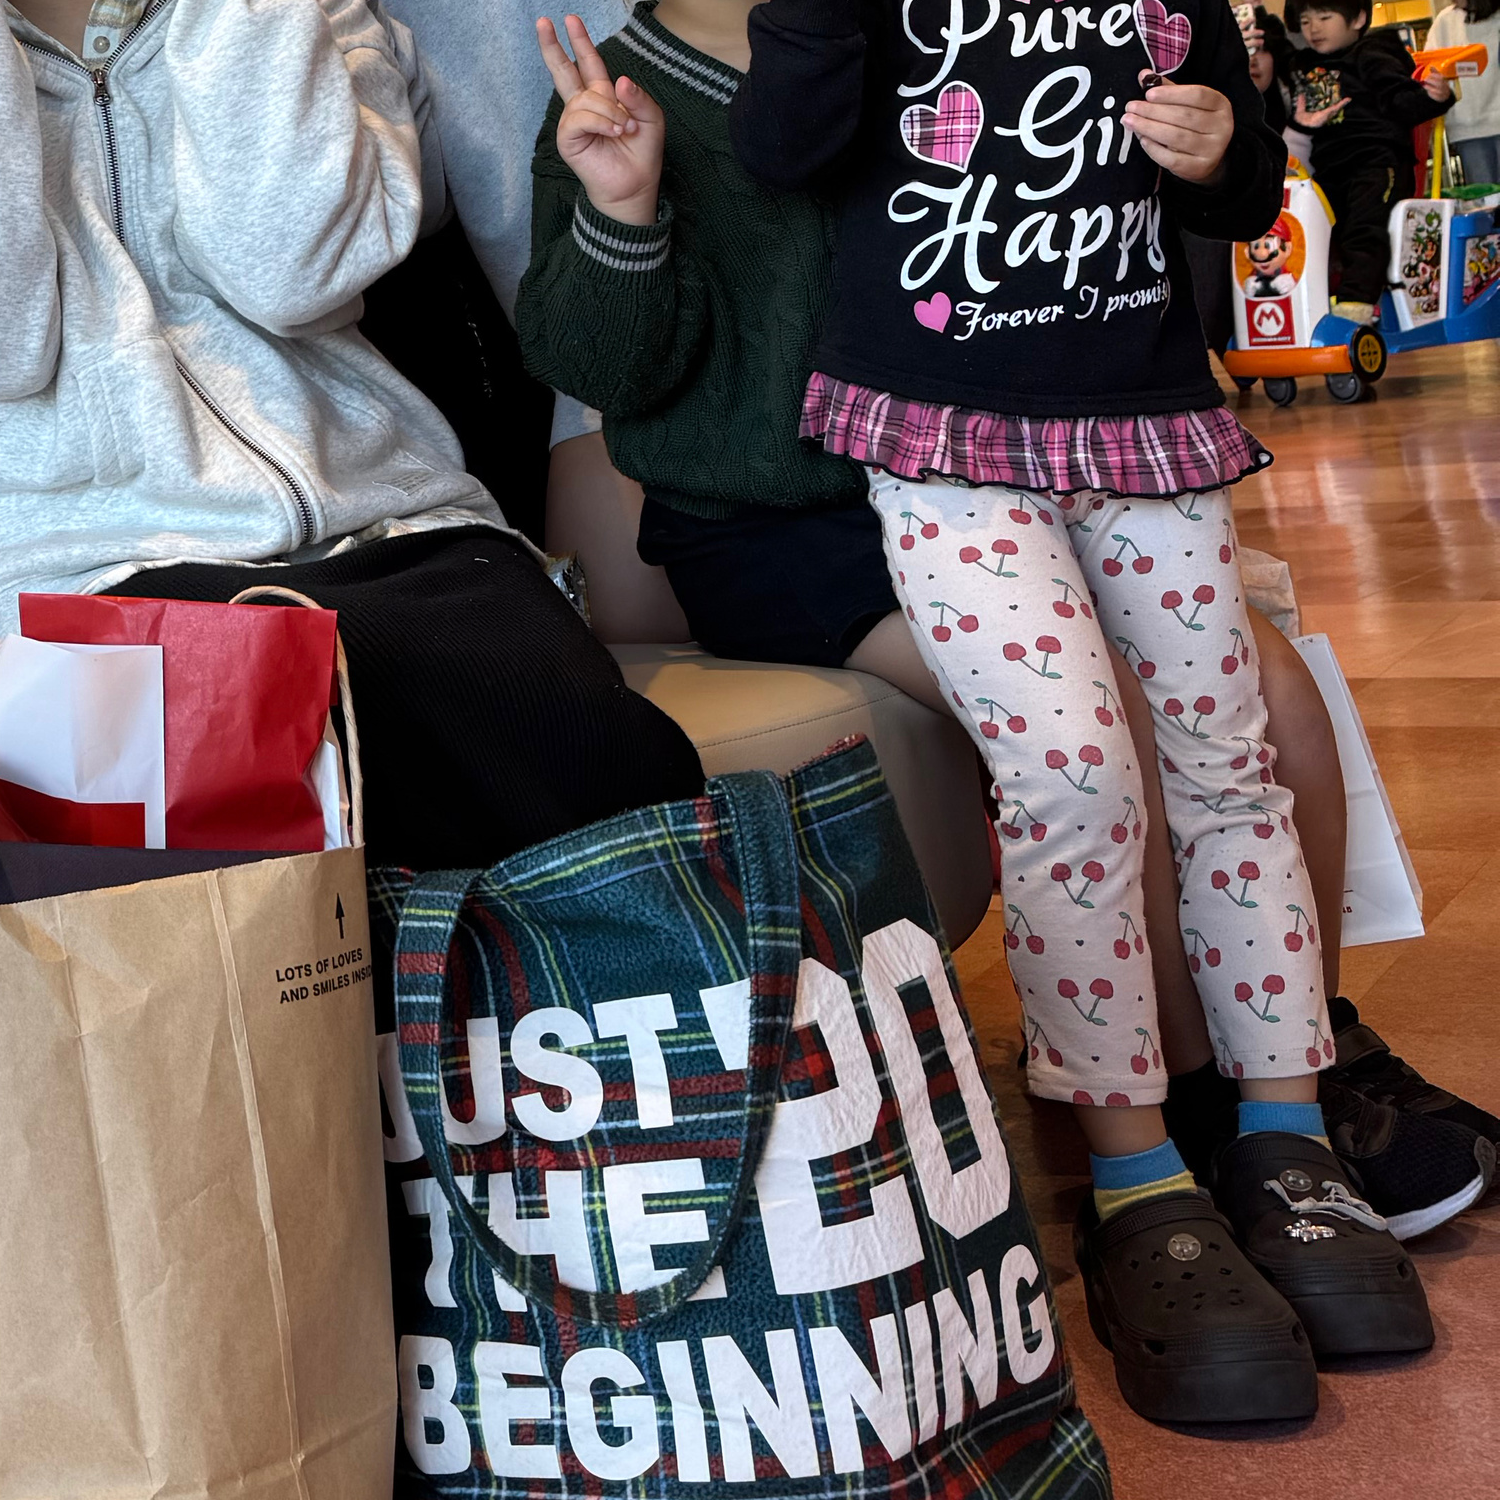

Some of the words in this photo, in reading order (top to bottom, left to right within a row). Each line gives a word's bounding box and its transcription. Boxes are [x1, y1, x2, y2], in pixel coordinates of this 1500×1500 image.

[888, 172, 1166, 295] Happy
[954, 301, 1064, 341] Forever
[276, 963, 312, 983] LOTS
[316, 958, 329, 975] OF
[332, 947, 363, 969] LOVES
[280, 986, 309, 1004] AND
[313, 974, 350, 997] SMILES
[402, 1157, 728, 1312] THE
[400, 1243, 1056, 1483] BEGINNING
